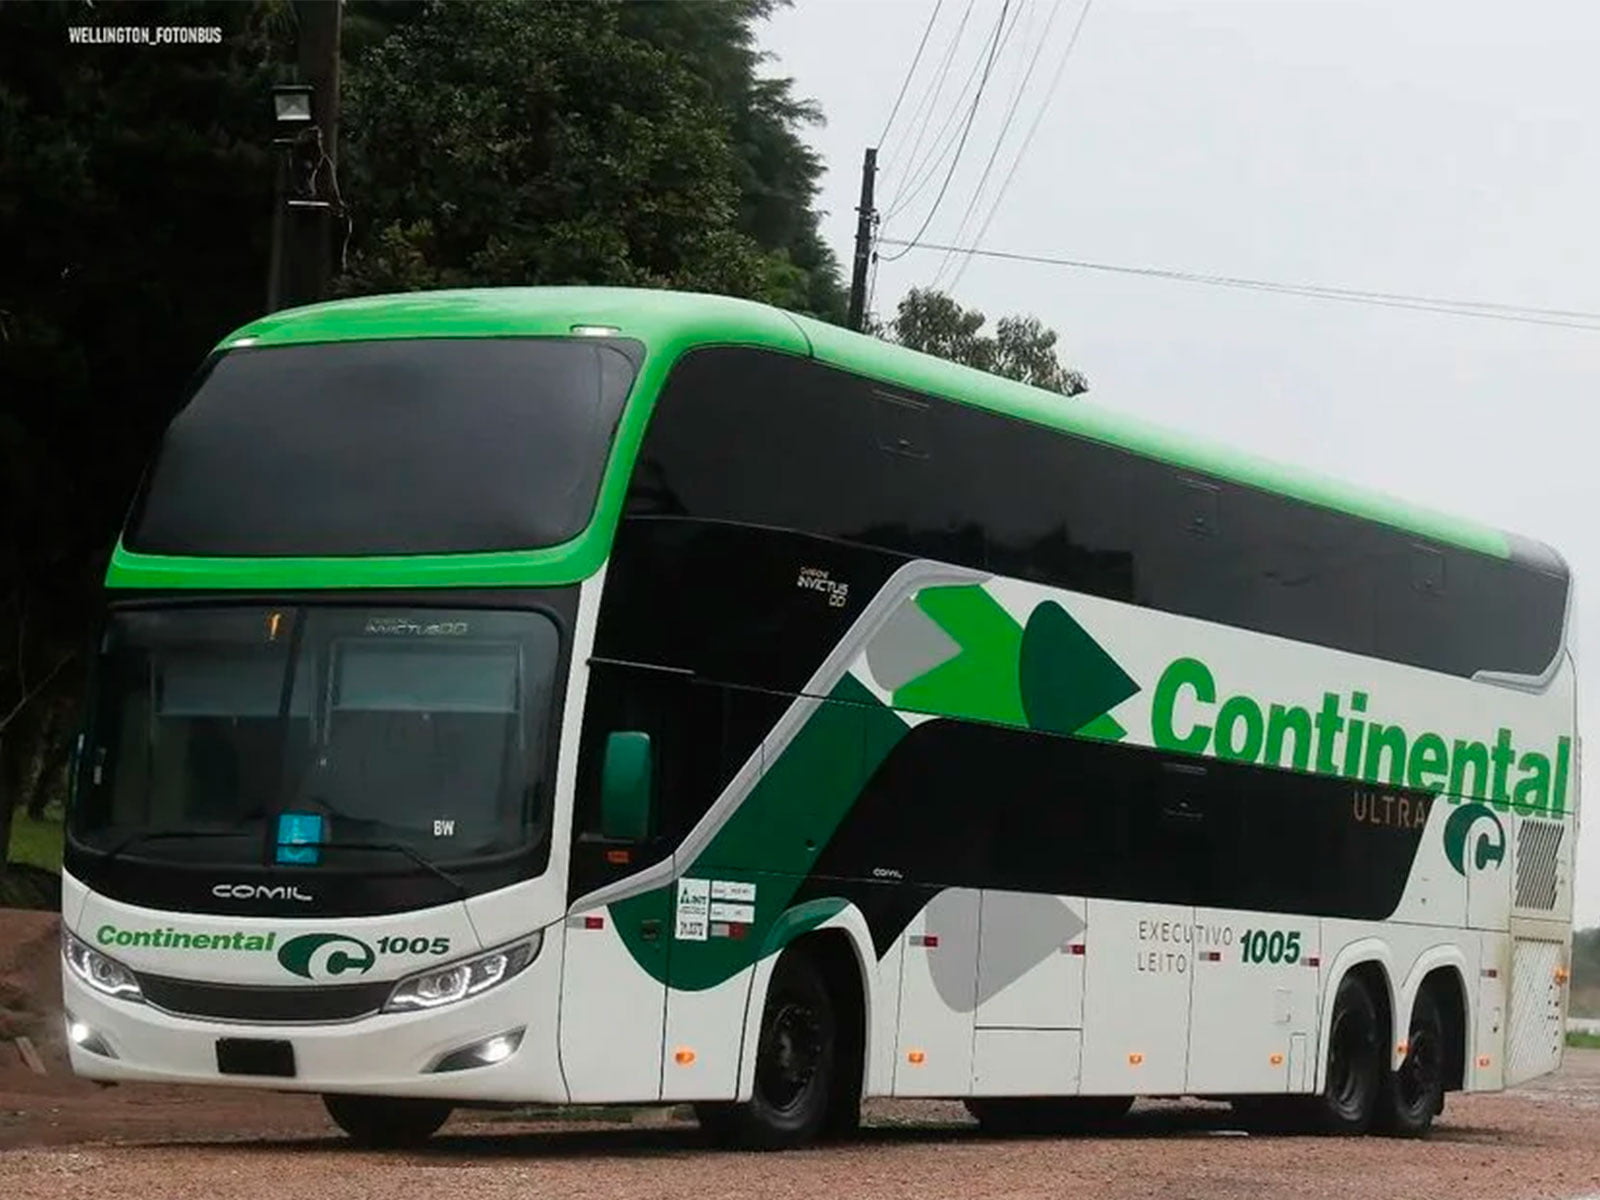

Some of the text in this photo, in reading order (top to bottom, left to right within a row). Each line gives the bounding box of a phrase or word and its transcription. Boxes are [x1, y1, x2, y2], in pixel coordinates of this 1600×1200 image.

[1151, 656, 1572, 820] Continental
[1352, 790, 1428, 829] ULTRA
[433, 819, 456, 836] BW
[212, 883, 312, 902] COMIL
[96, 924, 277, 952] Continental
[376, 936, 450, 956] 1005
[1138, 920, 1233, 946] EXECUTIVO
[1239, 929, 1302, 965] 1005
[1138, 952, 1187, 974] LEITO
